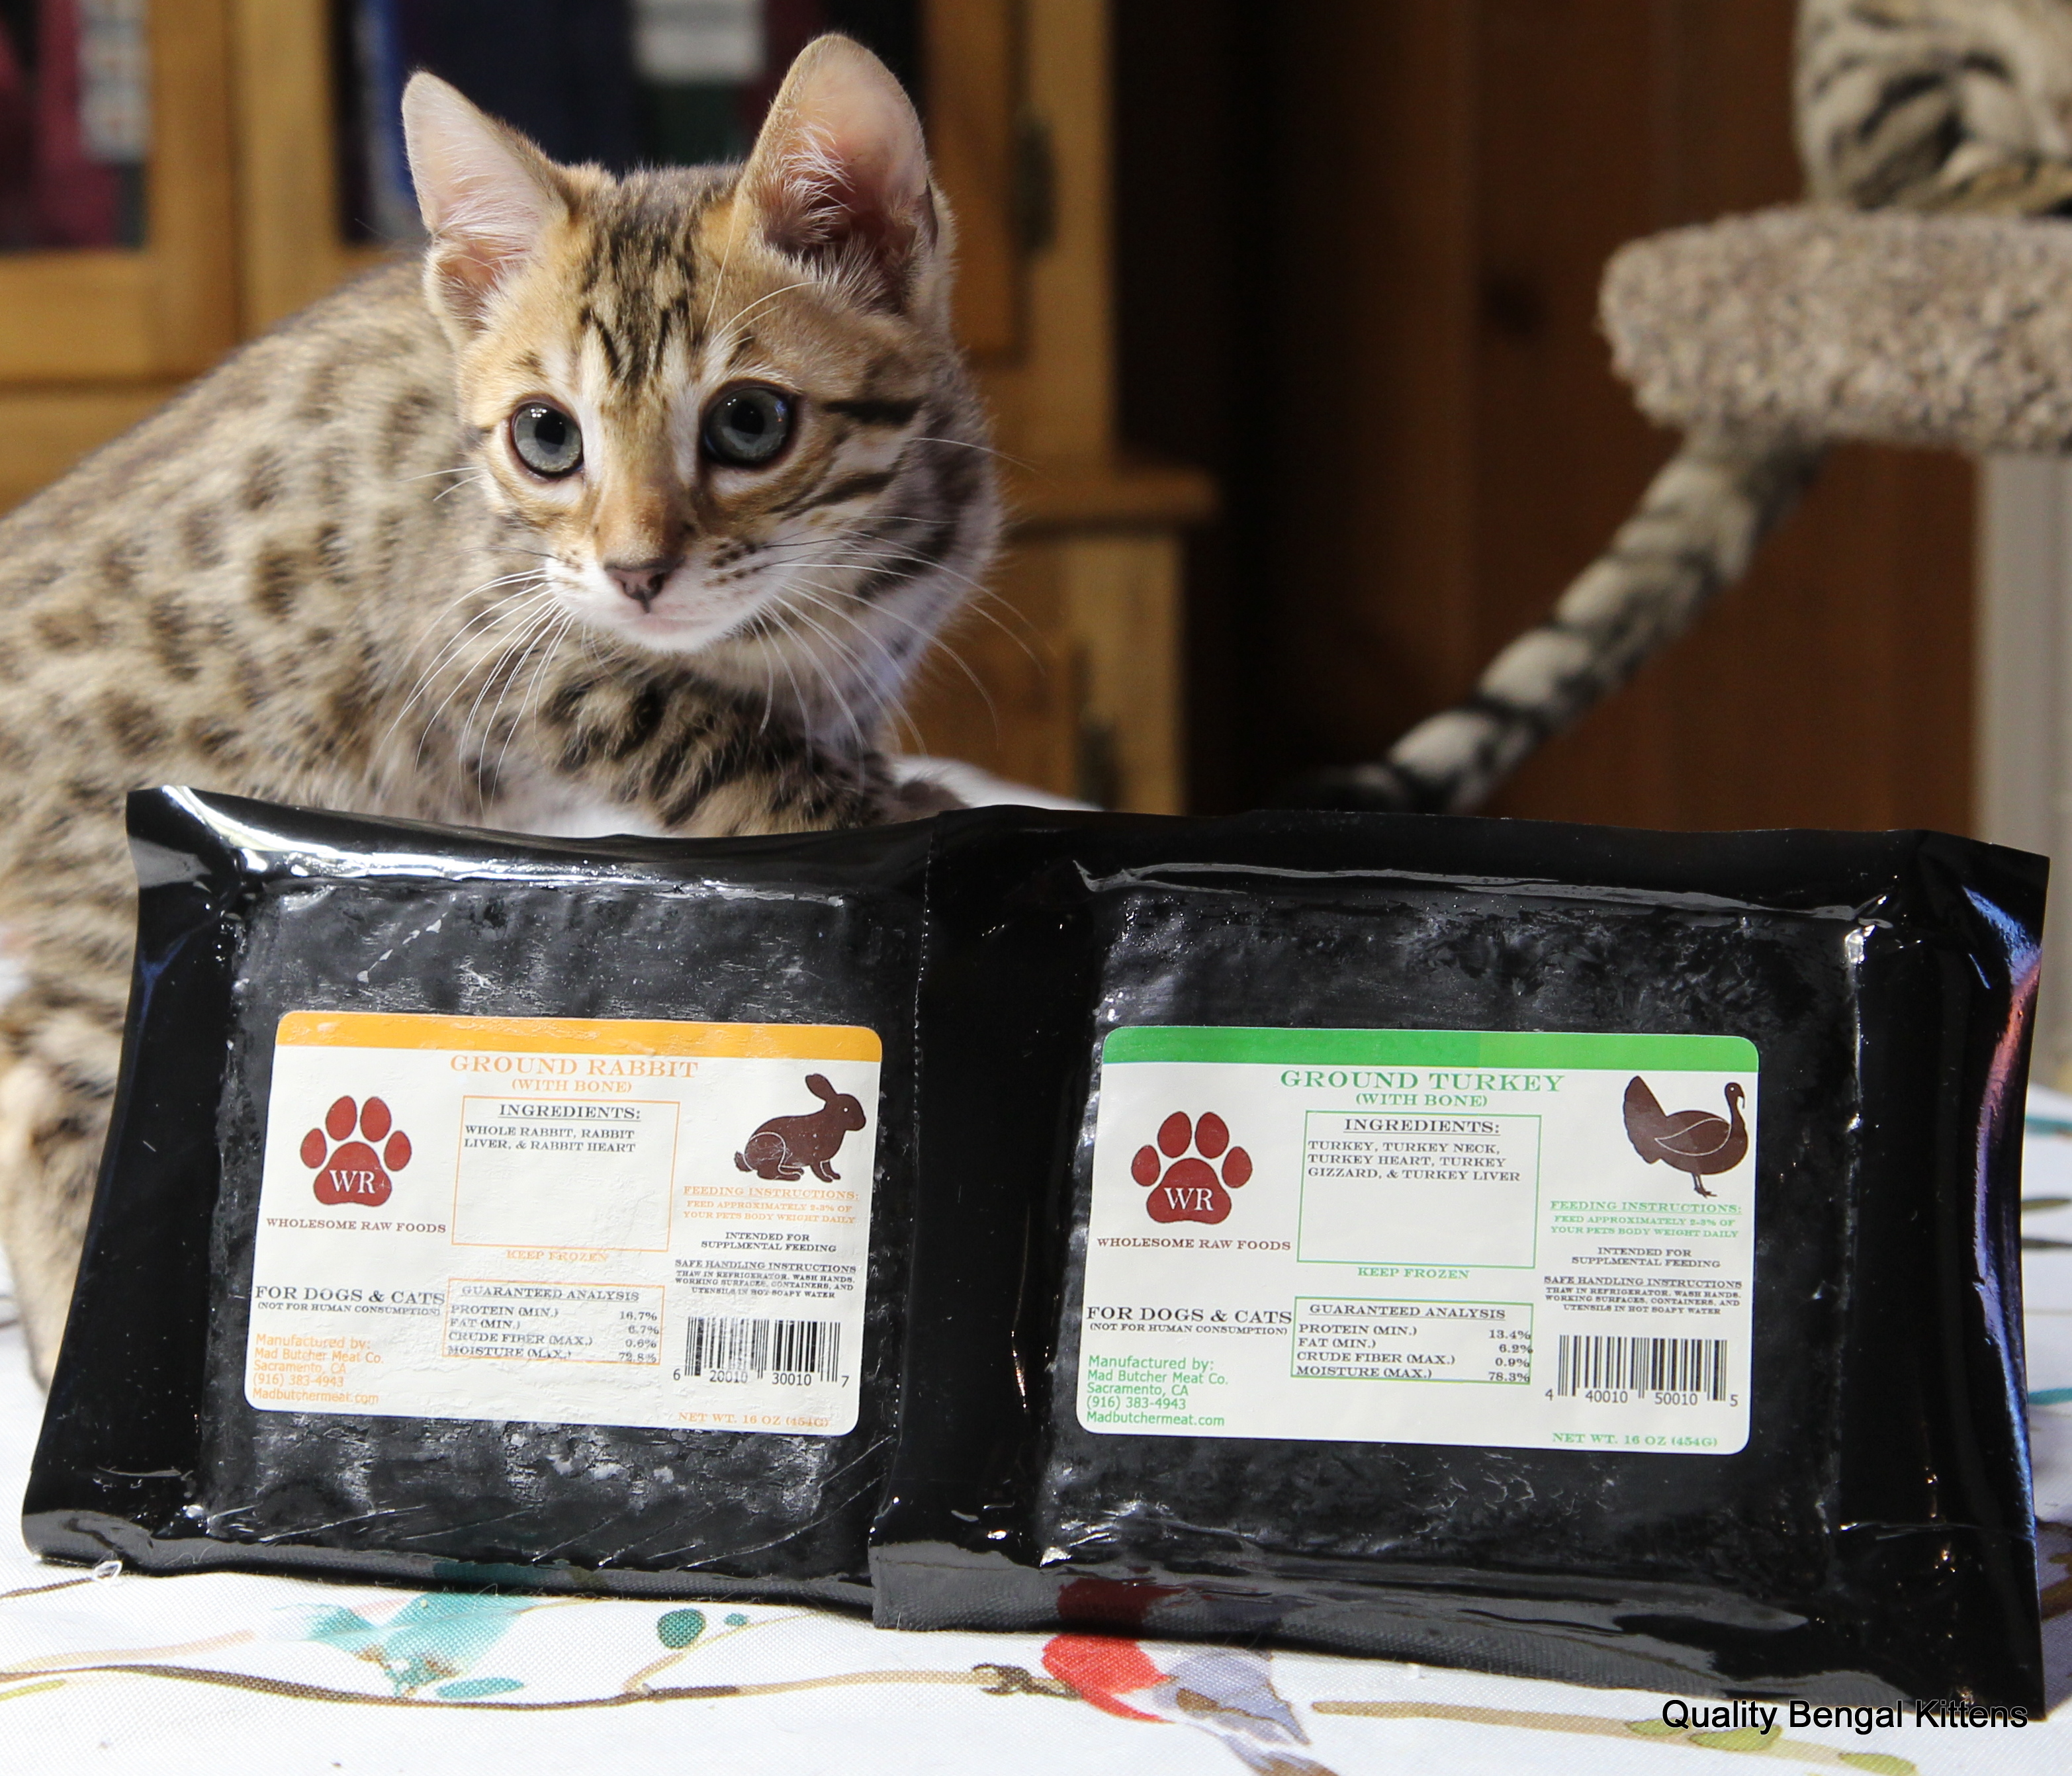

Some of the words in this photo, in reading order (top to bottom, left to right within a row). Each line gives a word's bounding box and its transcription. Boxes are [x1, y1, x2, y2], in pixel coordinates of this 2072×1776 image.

[449, 1055, 578, 1075] GROUND
[587, 1059, 698, 1078] RABBIT
[511, 1077, 569, 1091] (WITH
[573, 1079, 633, 1093] BONE)
[1280, 1070, 1418, 1088] GROUND
[1428, 1073, 1564, 1092] TURKEY
[1355, 1093, 1418, 1106] (WITH
[1423, 1094, 1488, 1107] BONE)
[498, 1104, 641, 1120] INGREDIENTS:
[465, 1124, 516, 1135] WHOLE
[520, 1126, 577, 1139] RABBIT,
[580, 1128, 635, 1139] RABBIT
[1344, 1118, 1501, 1133] INGREDIENTS:
[463, 1137, 512, 1149] LIVER,
[515, 1139, 527, 1150] &
[530, 1139, 584, 1152] RABBIT
[587, 1141, 636, 1153] HEART
[1308, 1141, 1378, 1151] TURKEY,
[1382, 1142, 1449, 1152] TURKEY
[1453, 1143, 1500, 1155] NECK,
[1307, 1154, 1374, 1164] TURKEY
[1377, 1155, 1435, 1167] HEART,
[1439, 1157, 1506, 1167] TURKEY
[327, 1169, 377, 1194] WR
[1308, 1168, 1383, 1178] GIZZARD,
[1386, 1169, 1399, 1178] &
[1402, 1170, 1468, 1180] TURKEY
[1473, 1171, 1520, 1181] LIVER
[683, 1186, 744, 1195] FEEDING
[748, 1188, 860, 1200] INSTRUCTIONS:
[1163, 1187, 1214, 1211] WR
[1550, 1201, 1617, 1210] FEEDING
[1622, 1202, 1742, 1213] INSTRUCTIONS:
[266, 1218, 356, 1229] WHOLESOME
[361, 1221, 393, 1231] RAW
[396, 1222, 446, 1233] FOODS
[1587, 1216, 1687, 1225] APPROXIMATELY
[1653, 1228, 1700, 1237] WEIGHT
[701, 1241, 782, 1250] SUPPLMENTAL
[785, 1243, 836, 1253] FEEDING
[1096, 1237, 1194, 1248] WHOLESOME
[1198, 1239, 1234, 1249] RAW
[1237, 1240, 1291, 1251] FOODS
[1666, 1249, 1691, 1257] FOR
[1571, 1257, 1662, 1266] SUPPLMENTAL
[1664, 1259, 1721, 1268] FEEDING
[1357, 1267, 1400, 1277] KEEP
[1404, 1268, 1470, 1278] FROZEN
[1544, 1276, 1574, 1284] SAFE
[1578, 1277, 1644, 1286] HANDLING
[1646, 1279, 1742, 1288] INSTRUCTIONS
[254, 1286, 298, 1300] FOR
[304, 1287, 363, 1302] DOGS
[369, 1290, 384, 1303] &
[390, 1290, 445, 1305] CATS
[461, 1286, 562, 1298] GUARANTEED
[566, 1290, 639, 1300] ANALYSIS
[257, 1301, 283, 1310] (NOT
[286, 1302, 308, 1311] FOR
[311, 1304, 351, 1313] HUMAN
[451, 1305, 514, 1315] PROTEIN
[518, 1307, 559, 1318] (MIN.)
[1309, 1304, 1420, 1316] GUARANTEED
[1425, 1308, 1506, 1318] ANALYSIS
[1086, 1306, 1133, 1320] FOR
[1139, 1308, 1204, 1321] DOGS
[1210, 1310, 1228, 1323] &
[1234, 1310, 1292, 1325] CATS
[449, 1317, 478, 1328] FAT
[480, 1319, 520, 1330] (MIN.)
[1089, 1322, 1118, 1331] (NOT
[1120, 1323, 1145, 1332] FOR
[1149, 1324, 1193, 1333] HUMAN
[1196, 1326, 1288, 1335] CONSUMPTION)
[448, 1331, 498, 1343] CRUDE
[502, 1333, 545, 1345] FIBER
[548, 1335, 593, 1346] (MAX.)
[1298, 1324, 1369, 1334] PROTEIN
[1373, 1325, 1418, 1336] (MIN.)
[1488, 1329, 1531, 1339] 13.4%
[255, 1334, 345, 1348] Manufactured
[349, 1337, 371, 1353] by:
[1298, 1337, 1328, 1348] FAT
[1332, 1338, 1376, 1349] (MIN.)
[1499, 1343, 1534, 1354] 6.2%
[254, 1347, 278, 1359] Mad
[282, 1349, 327, 1361] Butcher
[332, 1351, 360, 1362] Meat
[365, 1352, 384, 1363] Co.
[1296, 1351, 1351, 1362] CRUDE
[1355, 1353, 1402, 1364] FIBER
[1406, 1354, 1455, 1365] (MAX.)
[1495, 1356, 1530, 1368] 0.9%
[253, 1360, 326, 1374] Sacramento,
[330, 1362, 347, 1374] CA
[1088, 1354, 1186, 1369] Manufactured
[1191, 1357, 1214, 1373] by:
[252, 1372, 285, 1388] (916)
[289, 1374, 344, 1388] 383-4943
[672, 1368, 681, 1381] 6
[772, 1372, 812, 1386] 30010
[840, 1375, 849, 1388] 7
[1087, 1369, 1113, 1381] Mad
[1118, 1370, 1166, 1383] Butcher
[1172, 1372, 1204, 1384] Meat
[1208, 1373, 1229, 1385] Co.
[1296, 1366, 1380, 1377] MOISTURE
[1383, 1368, 1432, 1380] (MAX.)
[1488, 1371, 1530, 1382] 78.3%
[252, 1388, 379, 1403] Madbutchermeat.com
[1087, 1382, 1166, 1397] Sacramento,
[1171, 1384, 1189, 1396] CA
[1086, 1395, 1121, 1410] (916)
[1126, 1397, 1187, 1409] 383-4943
[1545, 1388, 1553, 1401] 4
[1585, 1390, 1628, 1403] 40010
[1654, 1392, 1697, 1405] 50010
[1729, 1394, 1738, 1407] 5
[678, 1412, 707, 1423] NET
[713, 1413, 737, 1424] WT.
[743, 1415, 758, 1425] 16
[761, 1415, 781, 1425] OZ
[1086, 1411, 1225, 1426] Madbutchermeat.com
[1552, 1433, 1586, 1443] NET
[1590, 1433, 1618, 1444] WT.
[1625, 1435, 1640, 1444] 16
[1644, 1435, 1666, 1446] OZ
[1672, 1436, 1718, 1447] (454G)
